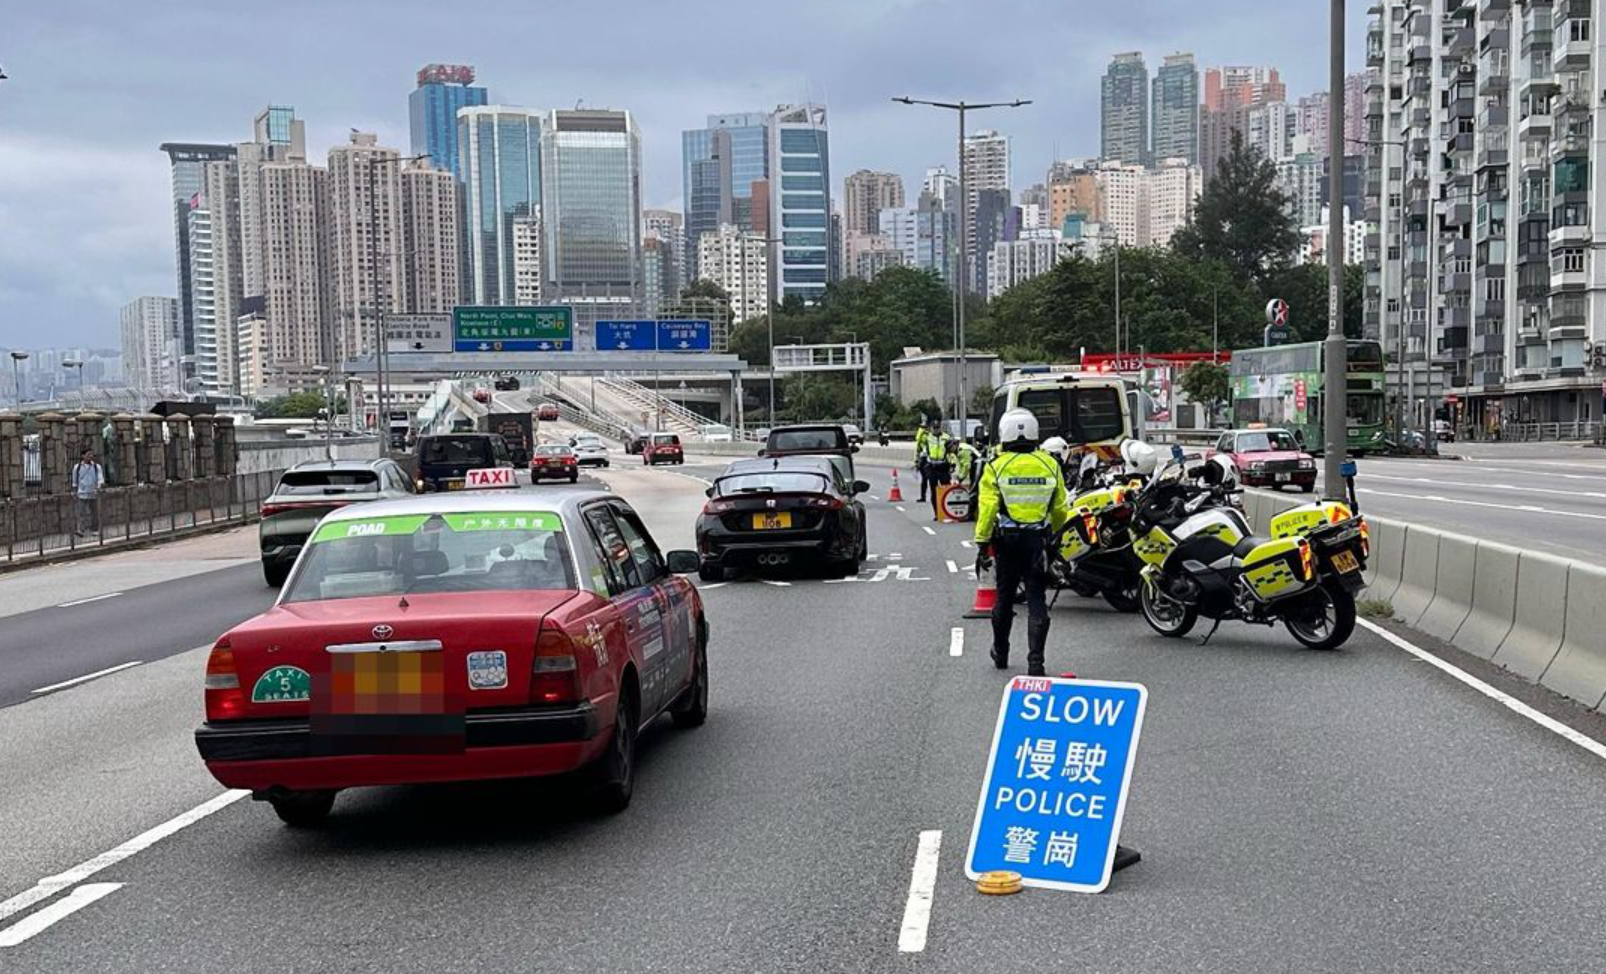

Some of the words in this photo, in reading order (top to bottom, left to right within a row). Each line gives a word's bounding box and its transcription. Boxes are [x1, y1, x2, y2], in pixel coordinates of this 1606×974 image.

[469, 470, 509, 485] TAXI
[347, 522, 386, 536] POAD
[264, 669, 303, 683] TAXI
[280, 677, 291, 691] 5
[1020, 693, 1125, 726] SLOW
[1014, 737, 1107, 785] 慢駛
[995, 787, 1106, 819] POLICE
[1003, 825, 1079, 868] 警崗
